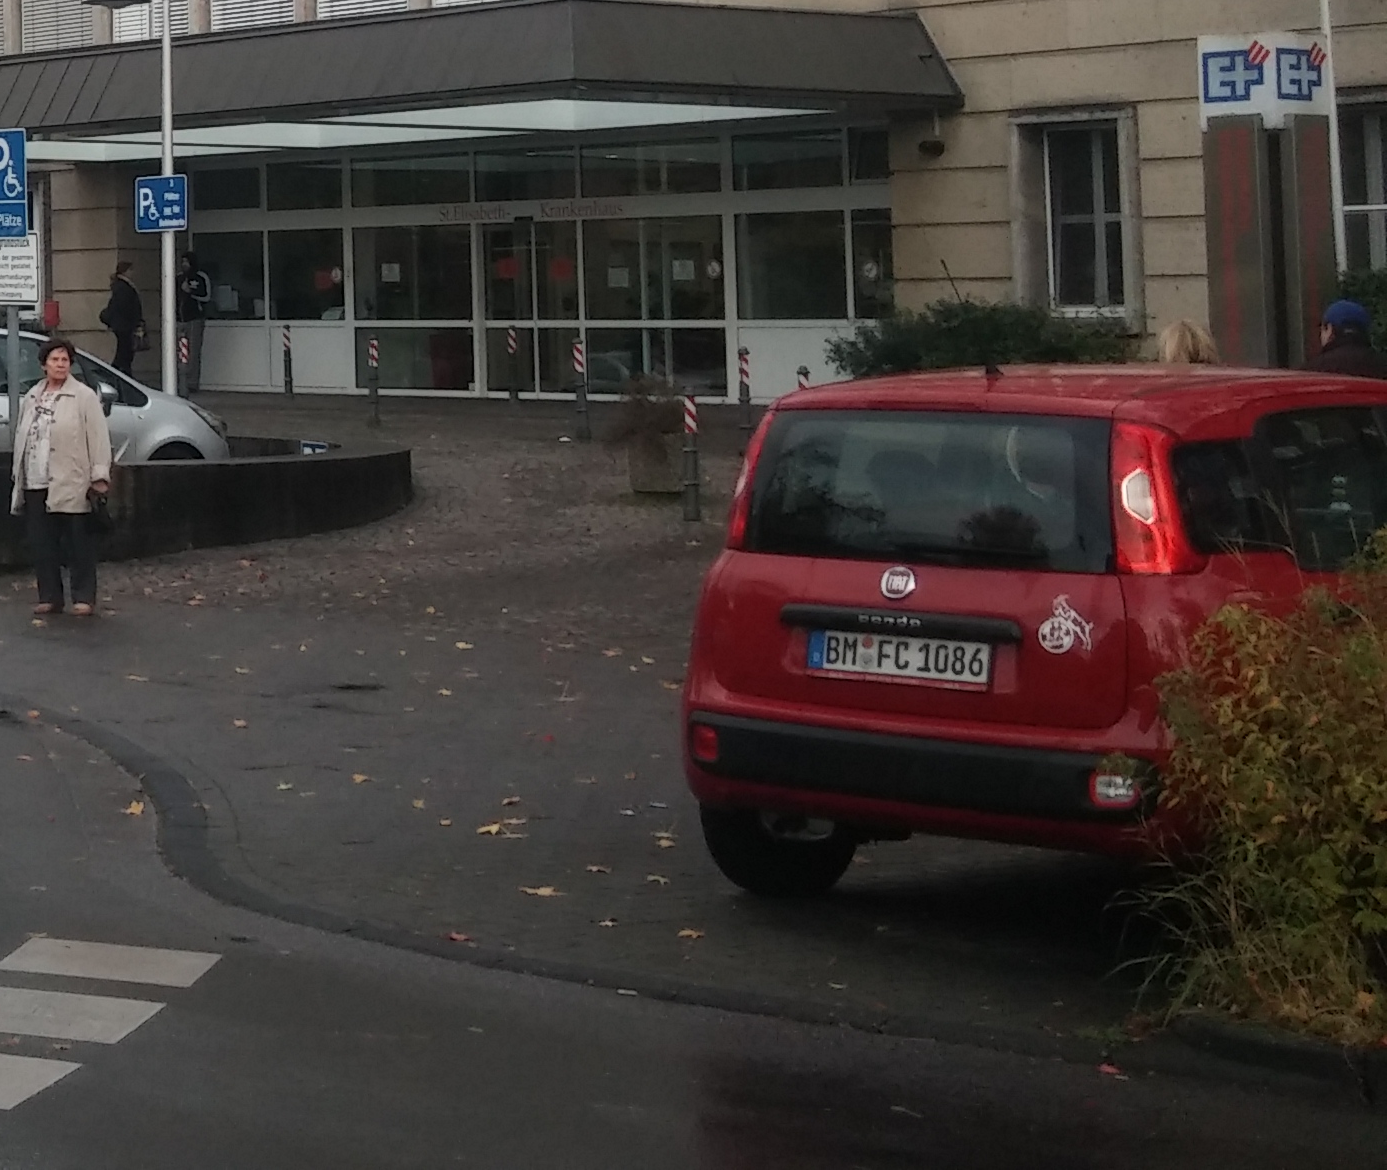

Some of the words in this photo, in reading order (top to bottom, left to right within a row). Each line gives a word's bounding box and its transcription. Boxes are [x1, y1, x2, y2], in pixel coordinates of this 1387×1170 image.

[139, 187, 153, 218] P
[540, 200, 623, 218] Krankenhaus
[827, 635, 858, 667] BM
[876, 639, 910, 670] FC
[916, 641, 984, 678] 1086
